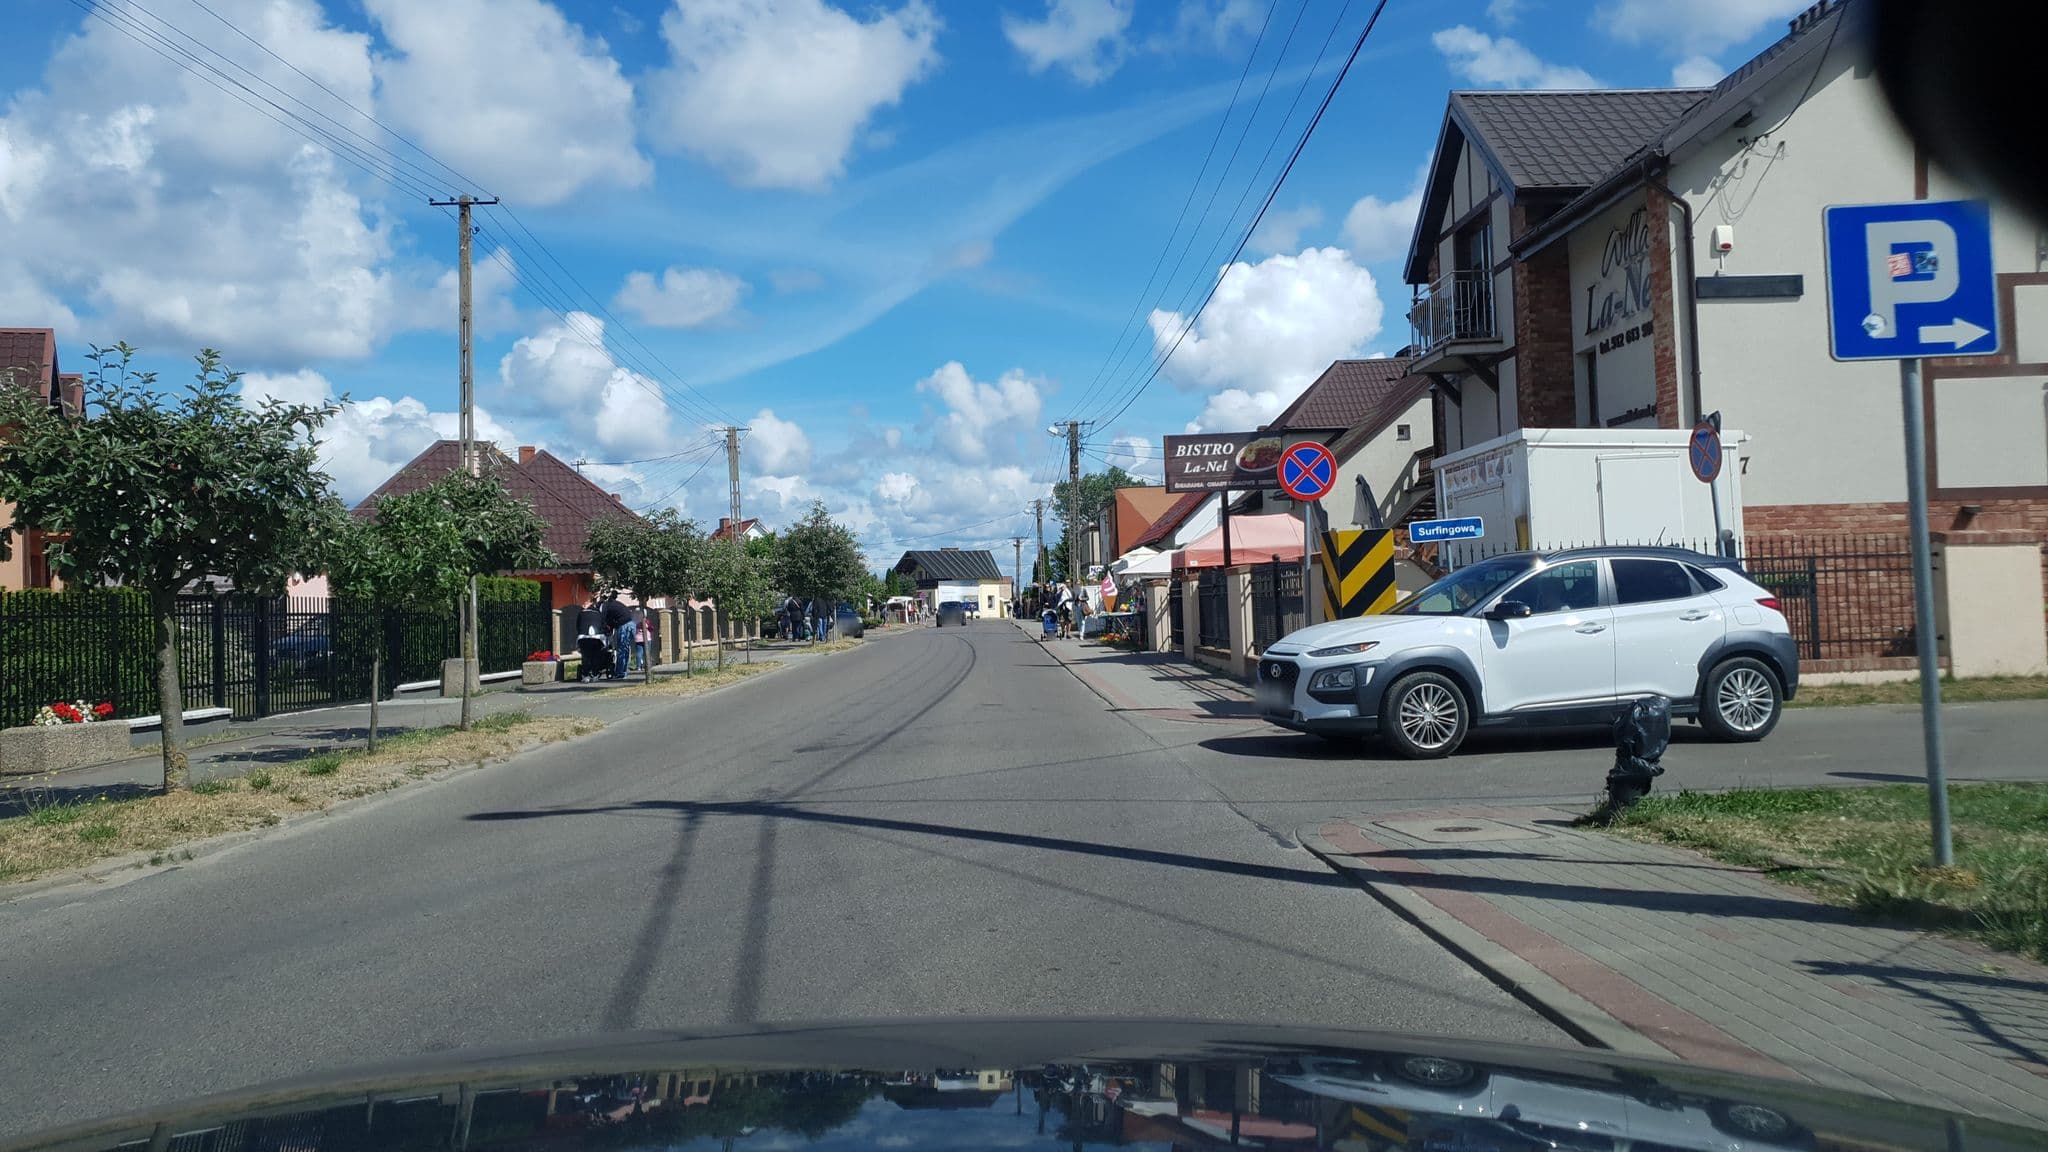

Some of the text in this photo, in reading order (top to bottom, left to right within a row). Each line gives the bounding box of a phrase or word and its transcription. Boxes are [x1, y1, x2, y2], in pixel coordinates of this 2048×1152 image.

[1865, 219, 1960, 339] P
[1585, 257, 1652, 336] La-Ne
[1175, 443, 1234, 457] BISTRO
[1184, 460, 1228, 473] La-Nel
[1739, 456, 1750, 475] 7
[1418, 525, 1475, 536] Surfingowa
